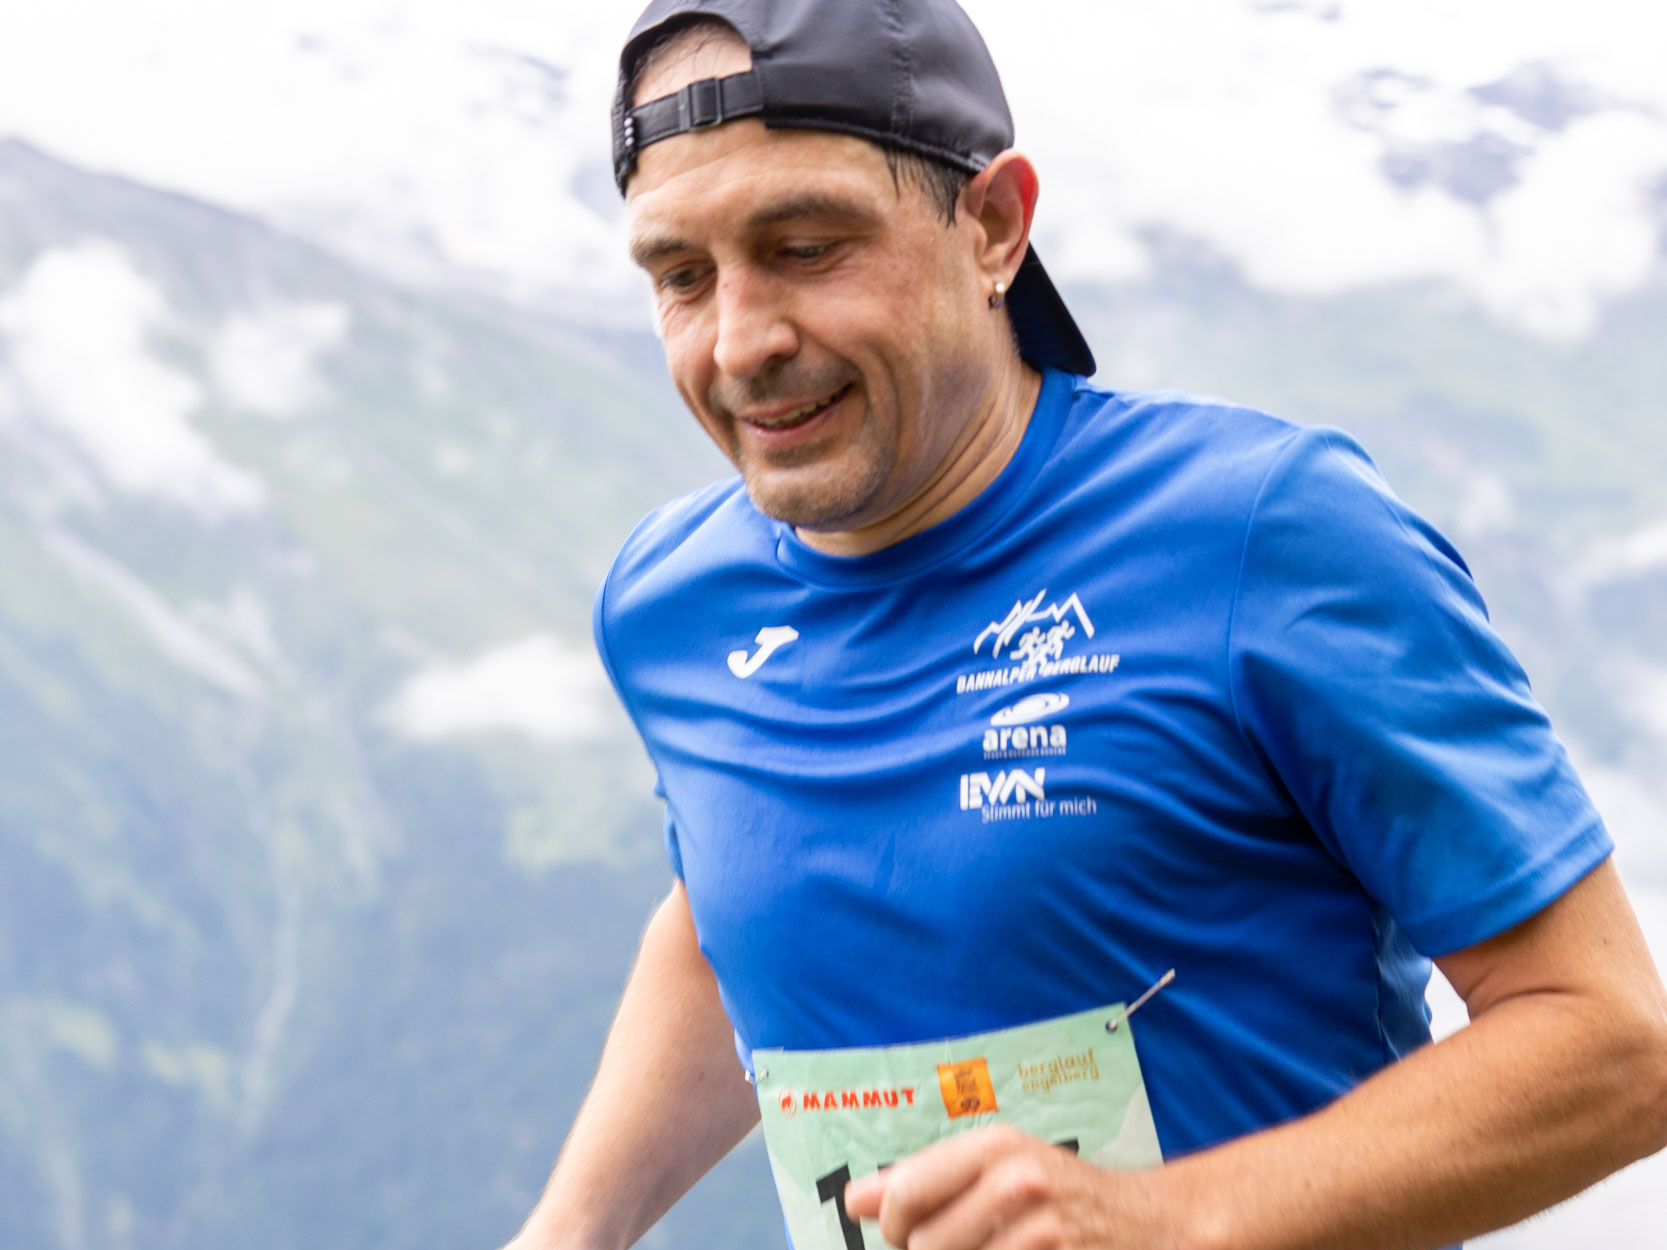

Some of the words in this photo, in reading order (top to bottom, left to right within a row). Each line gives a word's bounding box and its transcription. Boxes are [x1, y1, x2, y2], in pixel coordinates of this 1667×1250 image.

[956, 662, 1037, 694] BANNALPER
[1039, 654, 1120, 677] BERGLAUF
[983, 724, 1067, 751] arena
[982, 802, 1031, 824] Stimmt
[1035, 799, 1056, 818] für
[1060, 796, 1097, 815] mich
[1017, 1048, 1095, 1082] berglauf
[1022, 1064, 1099, 1092] engelberg
[803, 1087, 915, 1112] MAMMUT
